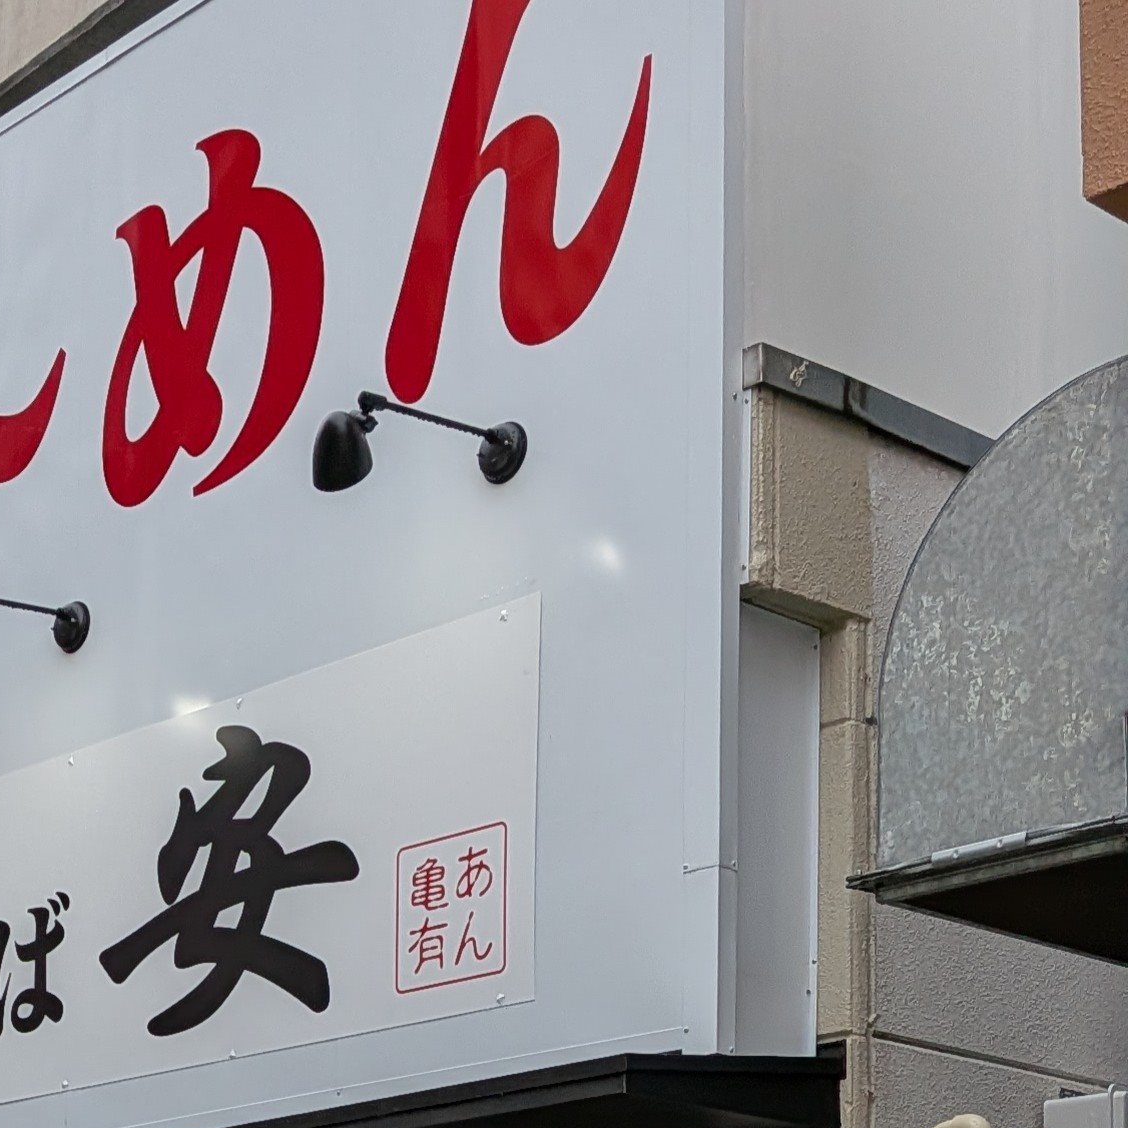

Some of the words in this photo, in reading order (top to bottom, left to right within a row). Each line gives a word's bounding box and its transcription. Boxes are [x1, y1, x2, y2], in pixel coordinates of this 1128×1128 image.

[98, 725, 360, 1037] 安
[408, 857, 449, 975] 亀有
[455, 846, 493, 966] あん
